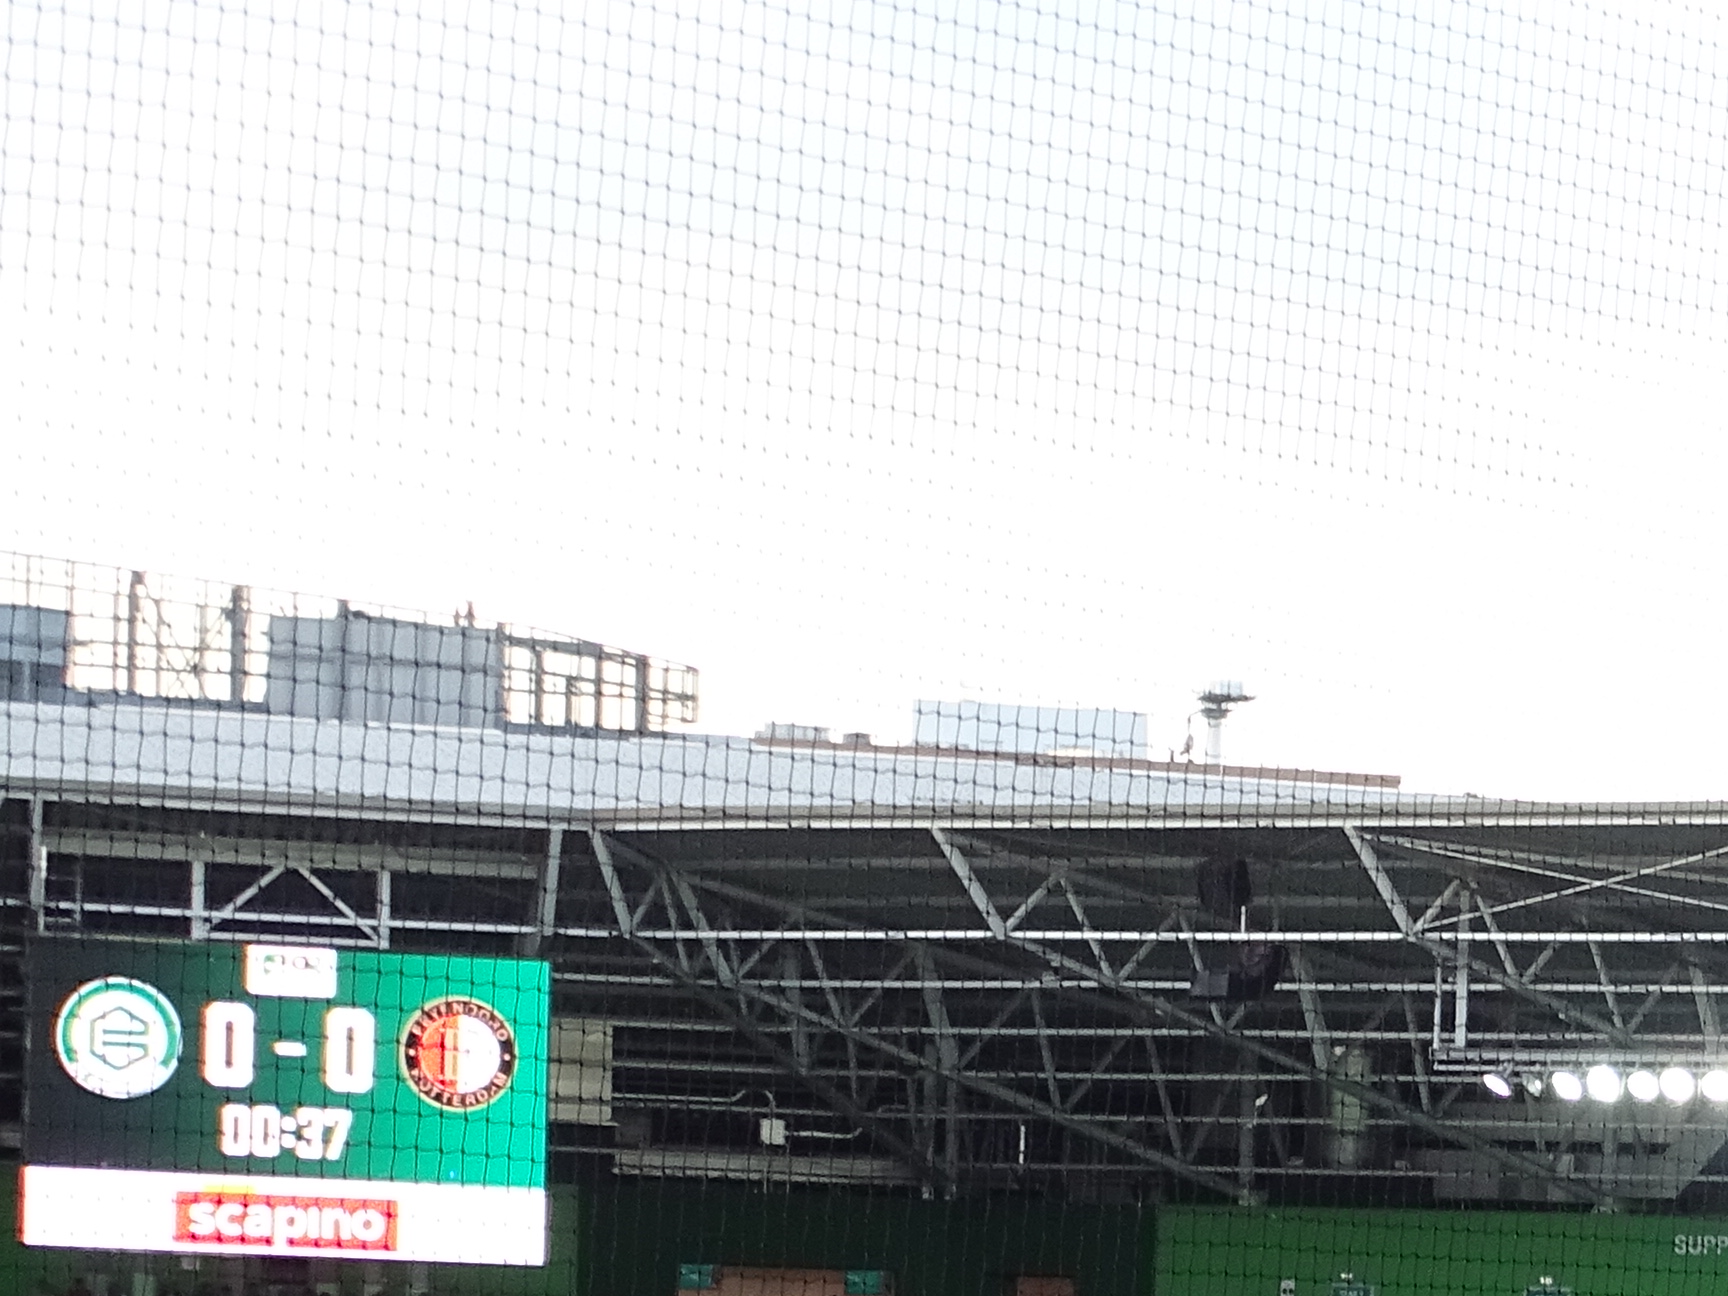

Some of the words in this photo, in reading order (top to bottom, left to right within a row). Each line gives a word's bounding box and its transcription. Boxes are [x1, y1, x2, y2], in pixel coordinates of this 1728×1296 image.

[201, 1001, 254, 1088] 0
[322, 1006, 375, 1094] 0
[410, 1070, 508, 1107] ROTTERDAM
[219, 1103, 352, 1161] 00:37
[187, 1203, 386, 1249] scapino
